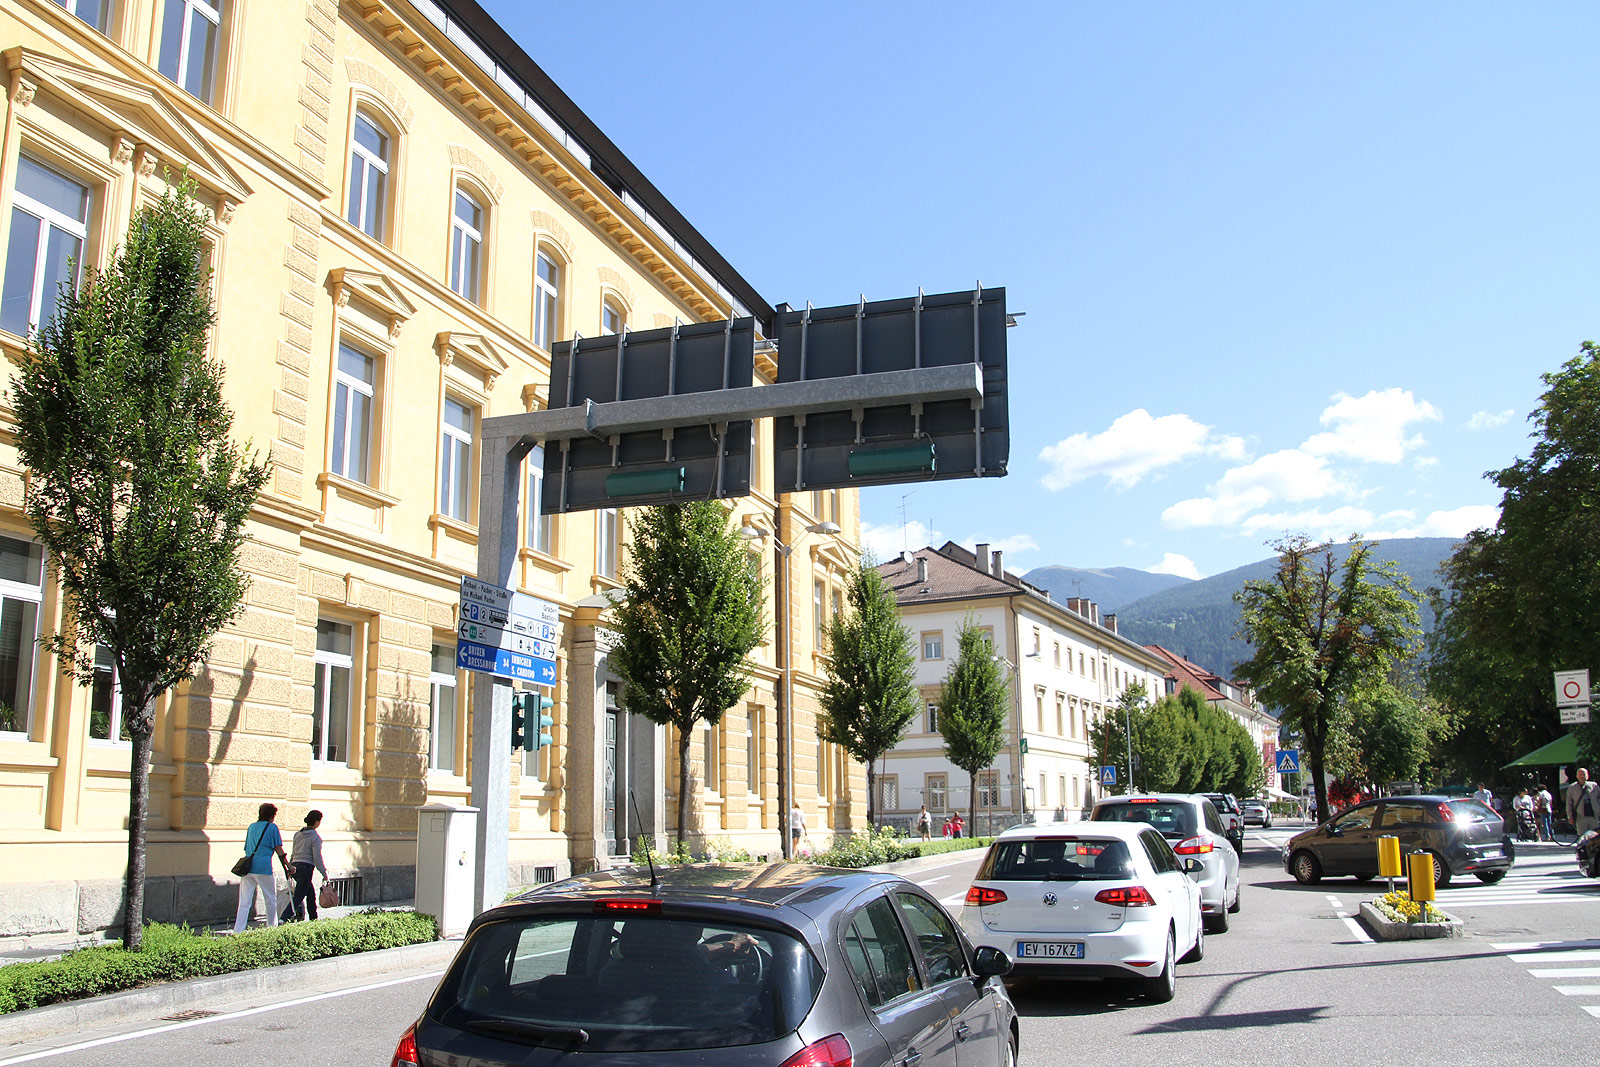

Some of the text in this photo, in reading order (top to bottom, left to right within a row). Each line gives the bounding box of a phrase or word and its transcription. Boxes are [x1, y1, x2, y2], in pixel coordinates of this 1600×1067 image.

[468, 645, 485, 657] BRIXEN
[468, 656, 497, 671] BRESSANONE
[503, 658, 509, 668] 34
[517, 667, 535, 679] CANDIDO
[1025, 944, 1076, 956] EV 167KZ
